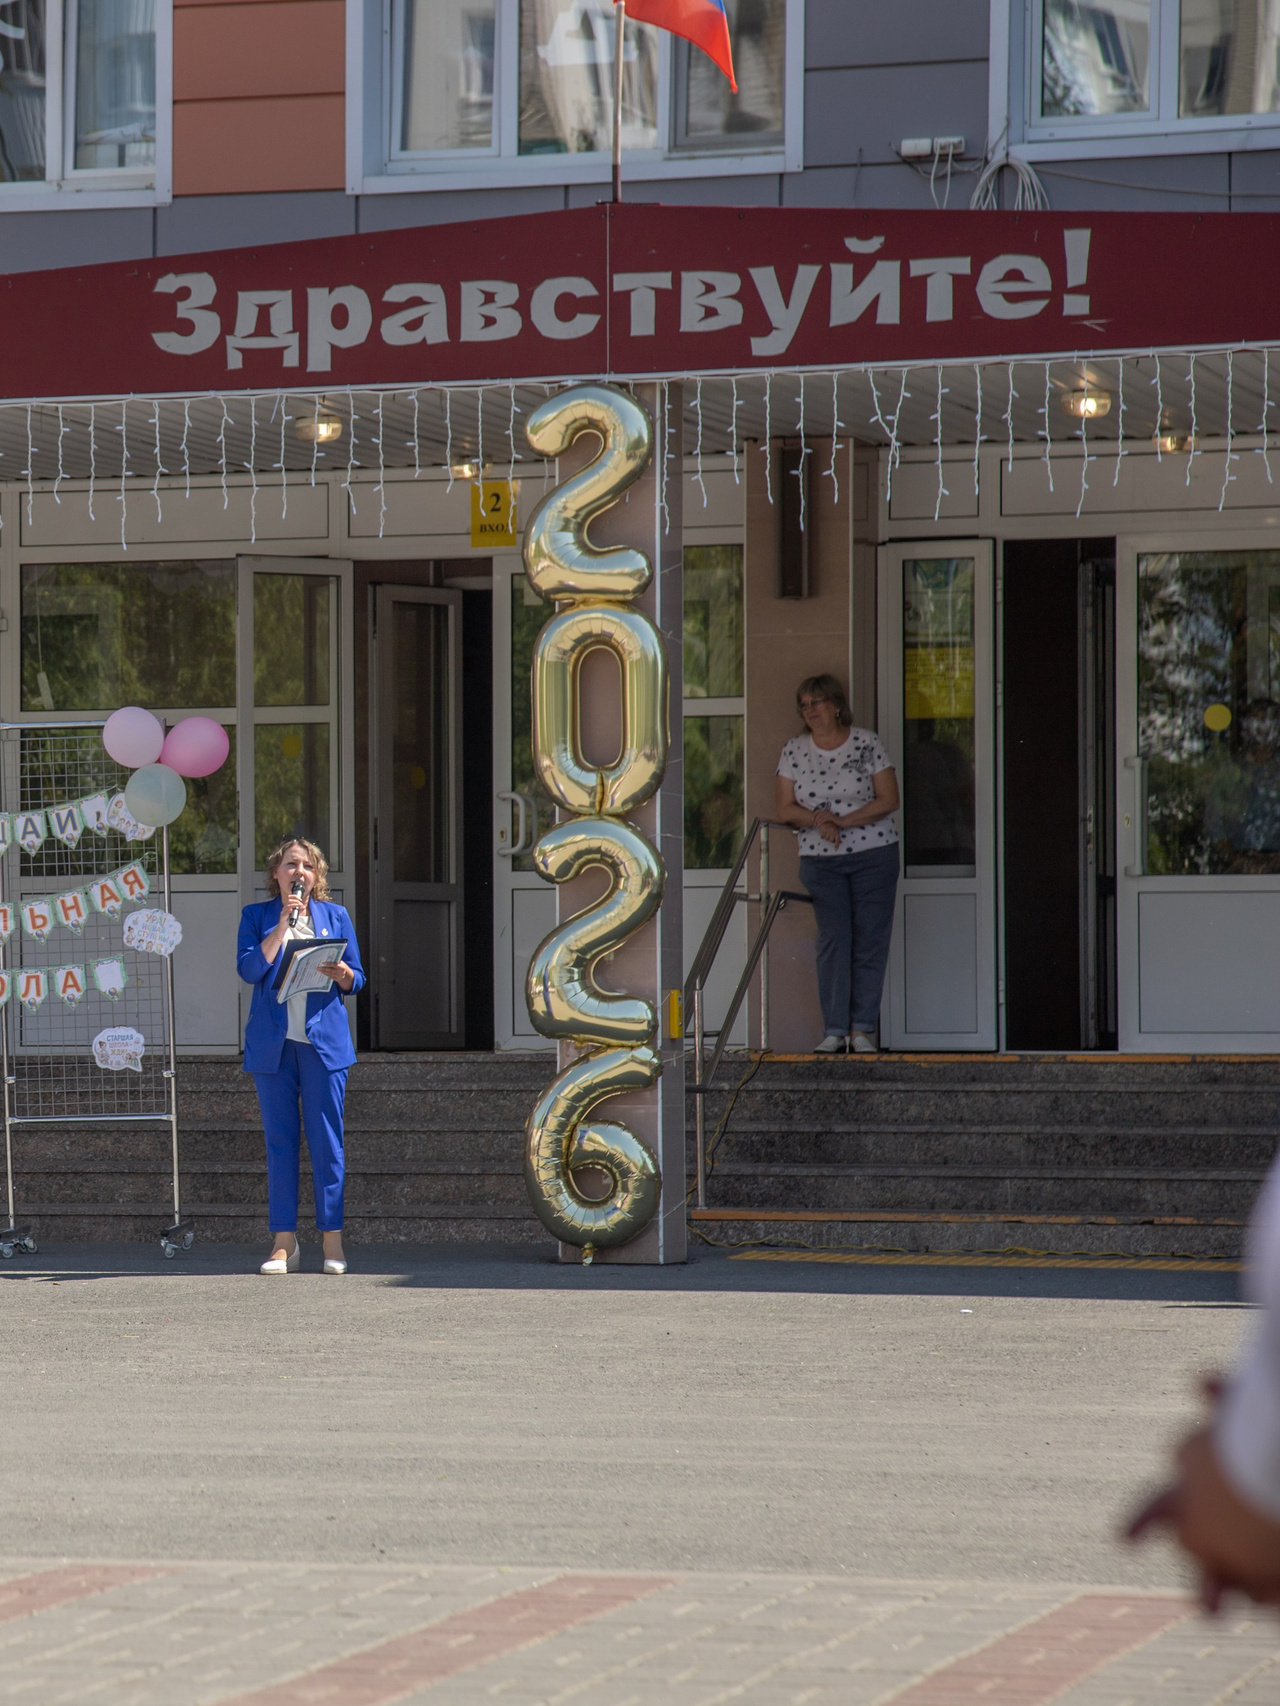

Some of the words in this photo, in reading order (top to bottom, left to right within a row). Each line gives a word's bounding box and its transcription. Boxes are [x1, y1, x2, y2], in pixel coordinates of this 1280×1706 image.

[151, 227, 1092, 374] Здравствуйте!
[489, 492, 502, 513] 2
[523, 384, 670, 1248] 2026
[106, 1034, 134, 1042] СТАРШАЯ
